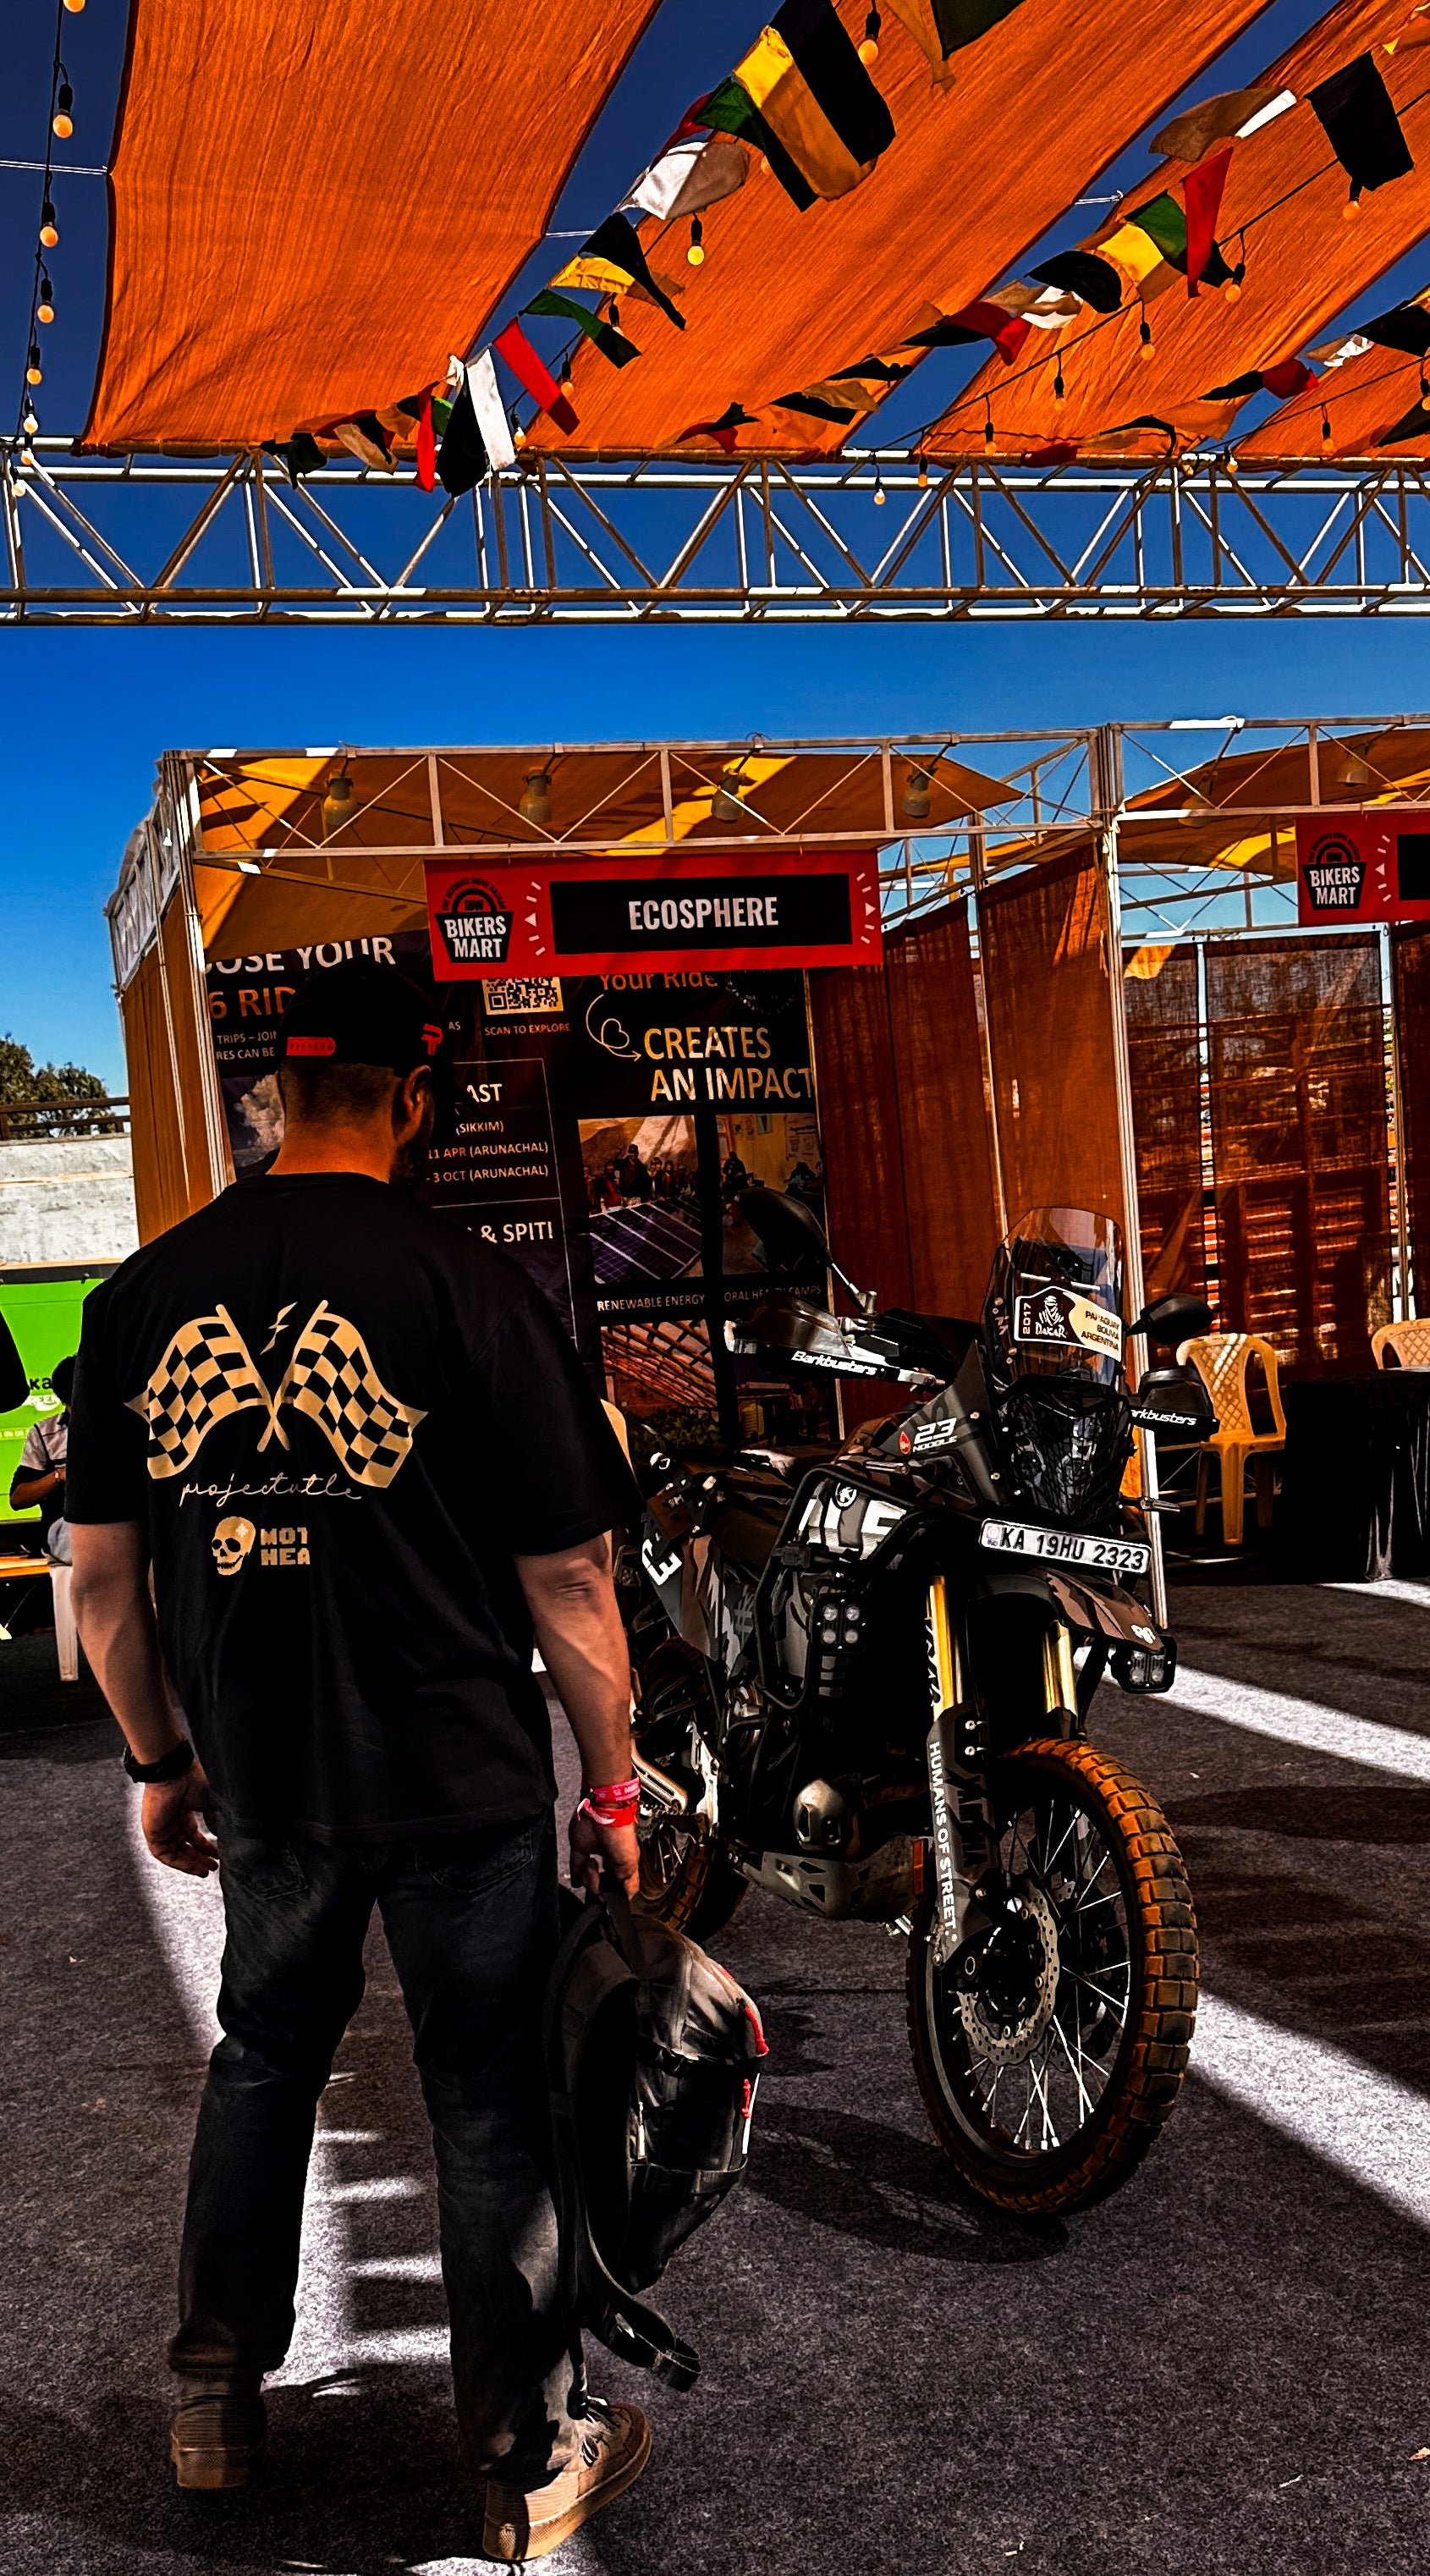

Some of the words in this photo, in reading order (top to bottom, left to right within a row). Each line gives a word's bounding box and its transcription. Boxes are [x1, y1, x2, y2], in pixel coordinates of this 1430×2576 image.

[1309, 866, 1360, 887] BIKERS
[1315, 887, 1356, 905] MART
[629, 896, 778, 930] ECOSPHERE
[444, 916, 506, 938] BIKERS
[453, 938, 503, 957] MART
[205, 953, 285, 975] OSE
[448, 1021, 461, 1031] AS
[484, 1026, 511, 1036] SCAN
[513, 1025, 527, 1035] TO
[529, 1022, 571, 1033] EXPLORE
[217, 1033, 246, 1044] TRIPS
[644, 1027, 772, 1060] CREATES
[237, 1048, 260, 1060] CAN
[261, 1047, 276, 1057] BE
[651, 1068, 696, 1102] AN
[706, 1067, 812, 1101] IMPACT
[455, 1120, 504, 1136] (SIKKIM)
[443, 1147, 467, 1159] APR
[470, 1141, 548, 1159] (ARUNACHAL)
[432, 1172, 440, 1183] 3
[443, 1170, 466, 1181] OCT
[469, 1164, 548, 1182] (ARUNACHAL)
[481, 1225, 498, 1244] &
[503, 1220, 553, 1243] SPITI
[597, 1296, 663, 1313] RENEWABLE
[665, 1293, 706, 1307] ENERGY
[723, 1291, 750, 1302] ORAL
[1023, 1302, 1031, 1335] 2017
[791, 1351, 877, 1375] Barkbusters
[1130, 1408, 1196, 1425] arkbusters
[914, 1417, 957, 1445] 23
[999, 1527, 1025, 1550] KA
[1037, 1533, 1086, 1560] 19HU
[1092, 1544, 1144, 1570] 2323
[929, 1742, 948, 1826] HUMANS
[938, 1828, 950, 1858] OF
